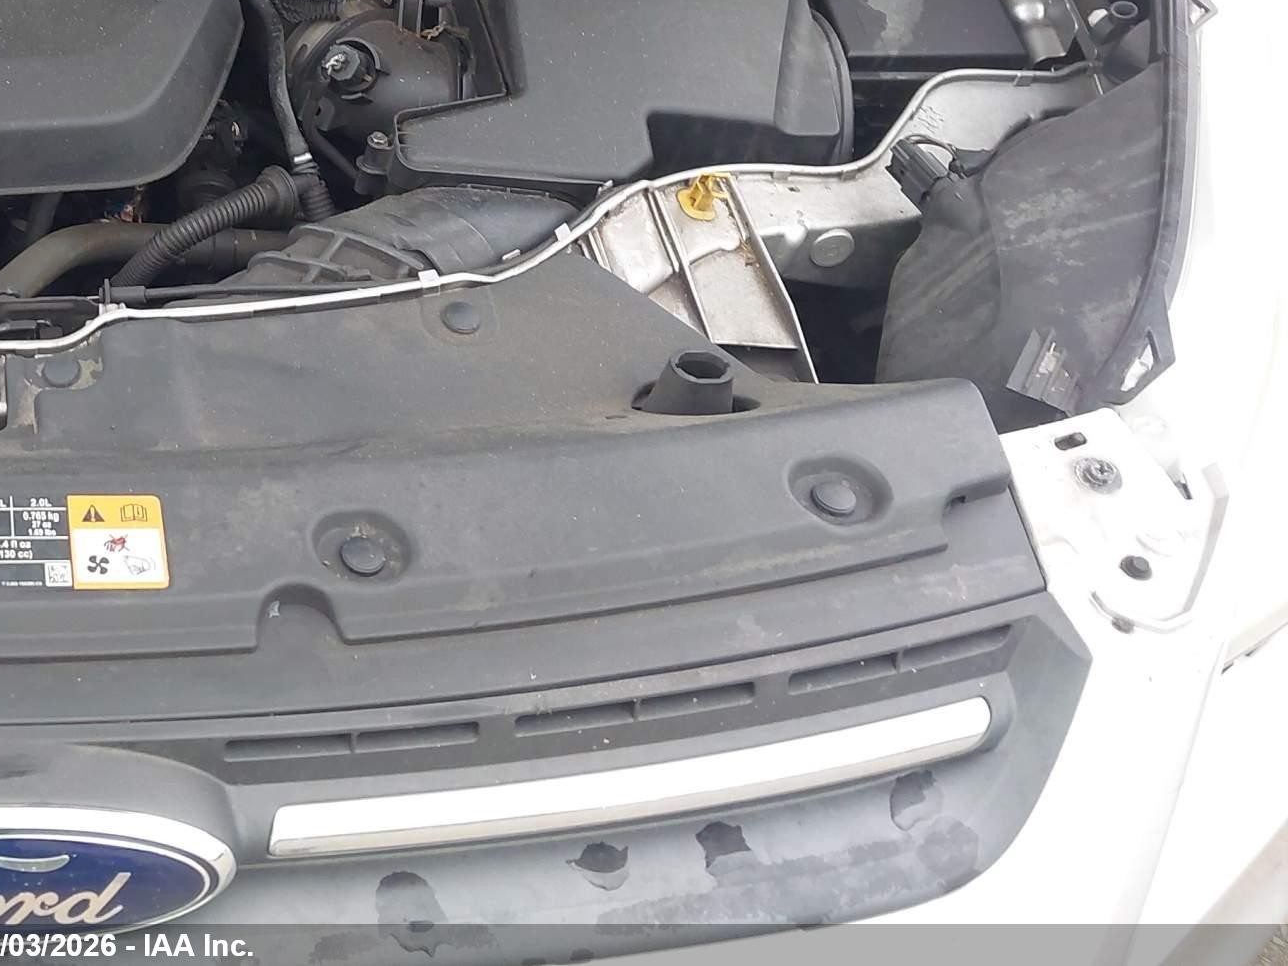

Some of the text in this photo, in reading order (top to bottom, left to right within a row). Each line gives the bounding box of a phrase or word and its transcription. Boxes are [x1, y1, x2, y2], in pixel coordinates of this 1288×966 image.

[30, 497, 53, 507] 2.0L
[48, 511, 60, 523] kg
[19, 541, 32, 549] oz
[17, 549, 33, 560] cc)
